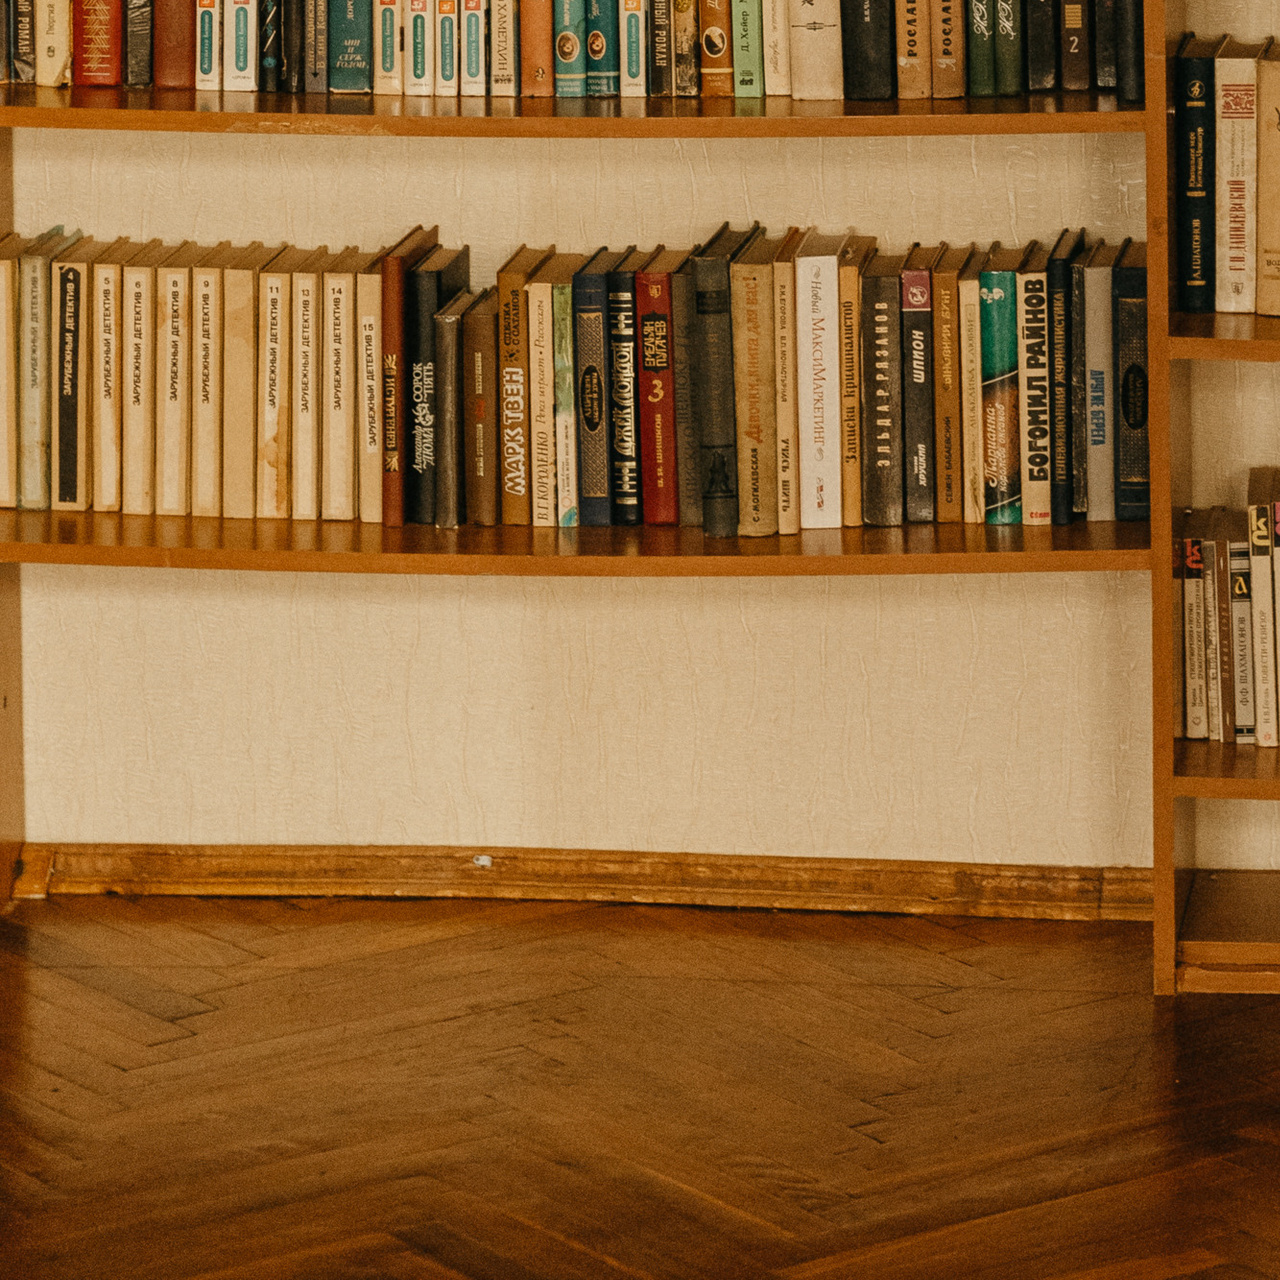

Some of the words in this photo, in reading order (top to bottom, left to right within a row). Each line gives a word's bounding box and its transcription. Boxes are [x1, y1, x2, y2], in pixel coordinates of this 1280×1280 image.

[20, 16, 30, 54] РОМАН
[1070, 36, 1079, 53] 2
[104, 277, 110, 285] 5
[104, 289, 112, 335] ДЕТЕКТИВ
[1022, 279, 1045, 369] РАЙНОВ
[645, 321, 655, 367] ЕМЕЛЬЯН
[656, 320, 667, 367] ПУГАЧЕВ
[913, 329, 925, 383] ШПИОН
[104, 338, 113, 398] ЗАРУБЕЖНЫЙ
[413, 363, 423, 402] СОРОК
[423, 363, 434, 395] ПЯТЬ
[503, 368, 524, 425] ТВЕН
[648, 380, 664, 403] 3
[845, 406, 856, 463] Записки
[1027, 376, 1048, 481] БОГОМИЛ
[502, 428, 524, 494] МАРК
[781, 438, 790, 473] УЧИСЬ
[781, 480, 790, 513] ШИТЬ
[1239, 617, 1247, 683] ШАХМАГОНОВ
